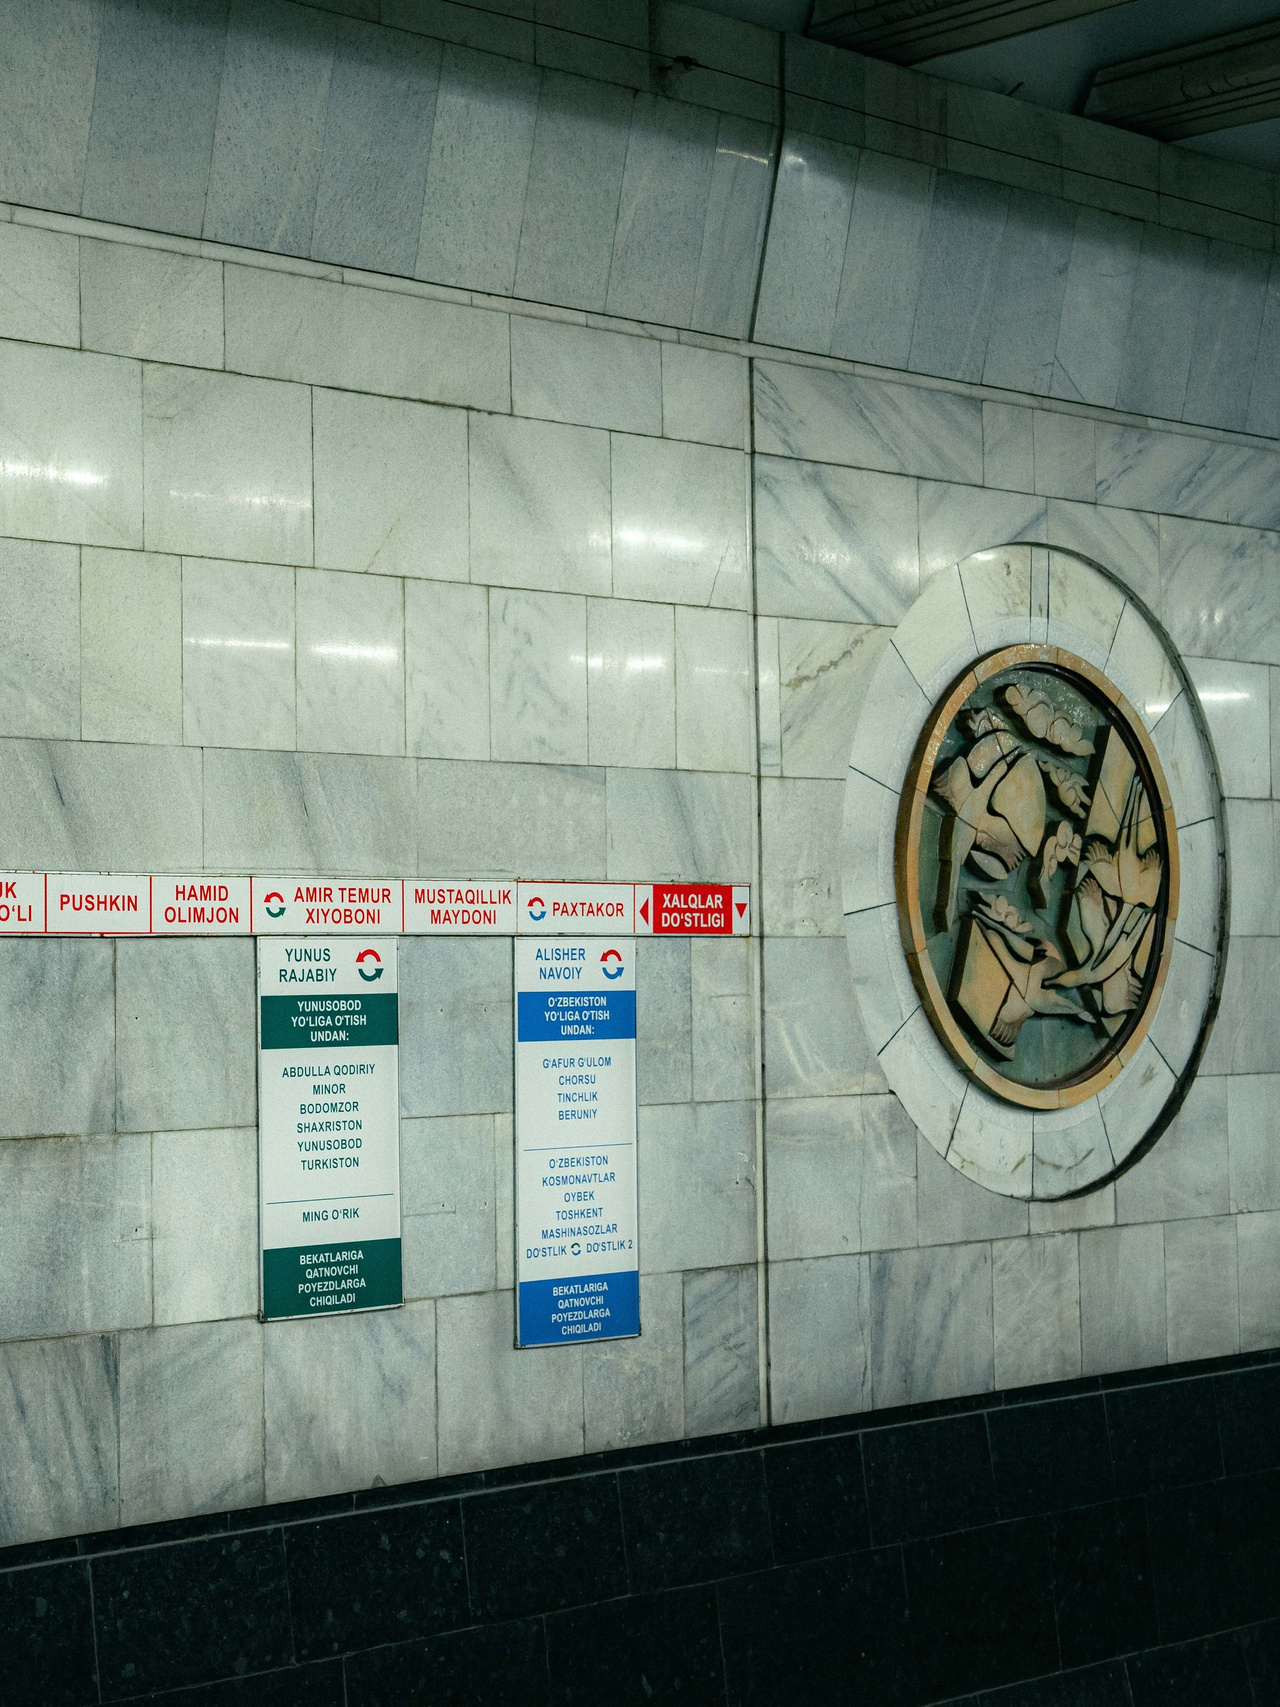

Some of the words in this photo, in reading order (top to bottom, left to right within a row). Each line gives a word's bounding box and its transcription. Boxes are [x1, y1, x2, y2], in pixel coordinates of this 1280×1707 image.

[176, 885, 228, 901] HAMID
[294, 887, 332, 904] AMIR
[338, 888, 391, 904] TEMUR
[415, 889, 512, 906] MUSTAQILLIK
[60, 894, 138, 911] PUSHKIN
[662, 893, 723, 909] XALQLAR
[165, 907, 239, 923] OLIMJON
[553, 902, 624, 917] PAXTAKOR
[306, 908, 381, 925] XIYOBONI
[431, 909, 497, 925] MAYDONI
[285, 949, 331, 961] YUNUS
[536, 948, 585, 960] ALISHER
[280, 969, 337, 982] RAJABIY
[540, 967, 582, 979] NAVOIY
[298, 1000, 361, 1012] YUNUSOBOD
[311, 1031, 349, 1042] UNDAN:
[561, 1025, 594, 1035] UNDAN:
[282, 1066, 331, 1078] ABDULLA
[334, 1064, 375, 1076] QODIRIY
[559, 1075, 596, 1085] CHORSU
[313, 1084, 346, 1095] MINOR
[558, 1092, 598, 1103] TINCHLIK
[300, 1102, 359, 1114] BODOMZOR
[559, 1109, 597, 1120] BERUNIY
[297, 1120, 362, 1133] SHAXRISTON
[298, 1138, 362, 1151] YUNUSOBOD
[301, 1157, 359, 1170] TURKISTON
[543, 1172, 615, 1186] KOSMONAVTLAR
[564, 1191, 594, 1202] OYBEK
[303, 1210, 328, 1222] MING
[556, 1208, 603, 1220] TOSHKENT
[542, 1224, 617, 1239] MASHINASOZLAR
[628, 1240, 632, 1249] 2
[300, 1250, 363, 1265] BEKATLARIGA
[306, 1265, 358, 1278] QATNOVCHI
[298, 1278, 366, 1293] POYEZDLARGA
[553, 1282, 608, 1296] BEKATLARIGA
[310, 1293, 355, 1307] CHIQILADI
[558, 1296, 603, 1309] QATNOVCHI
[552, 1309, 610, 1323] POYEZDLARGA
[562, 1322, 601, 1335] CHIQILADI
